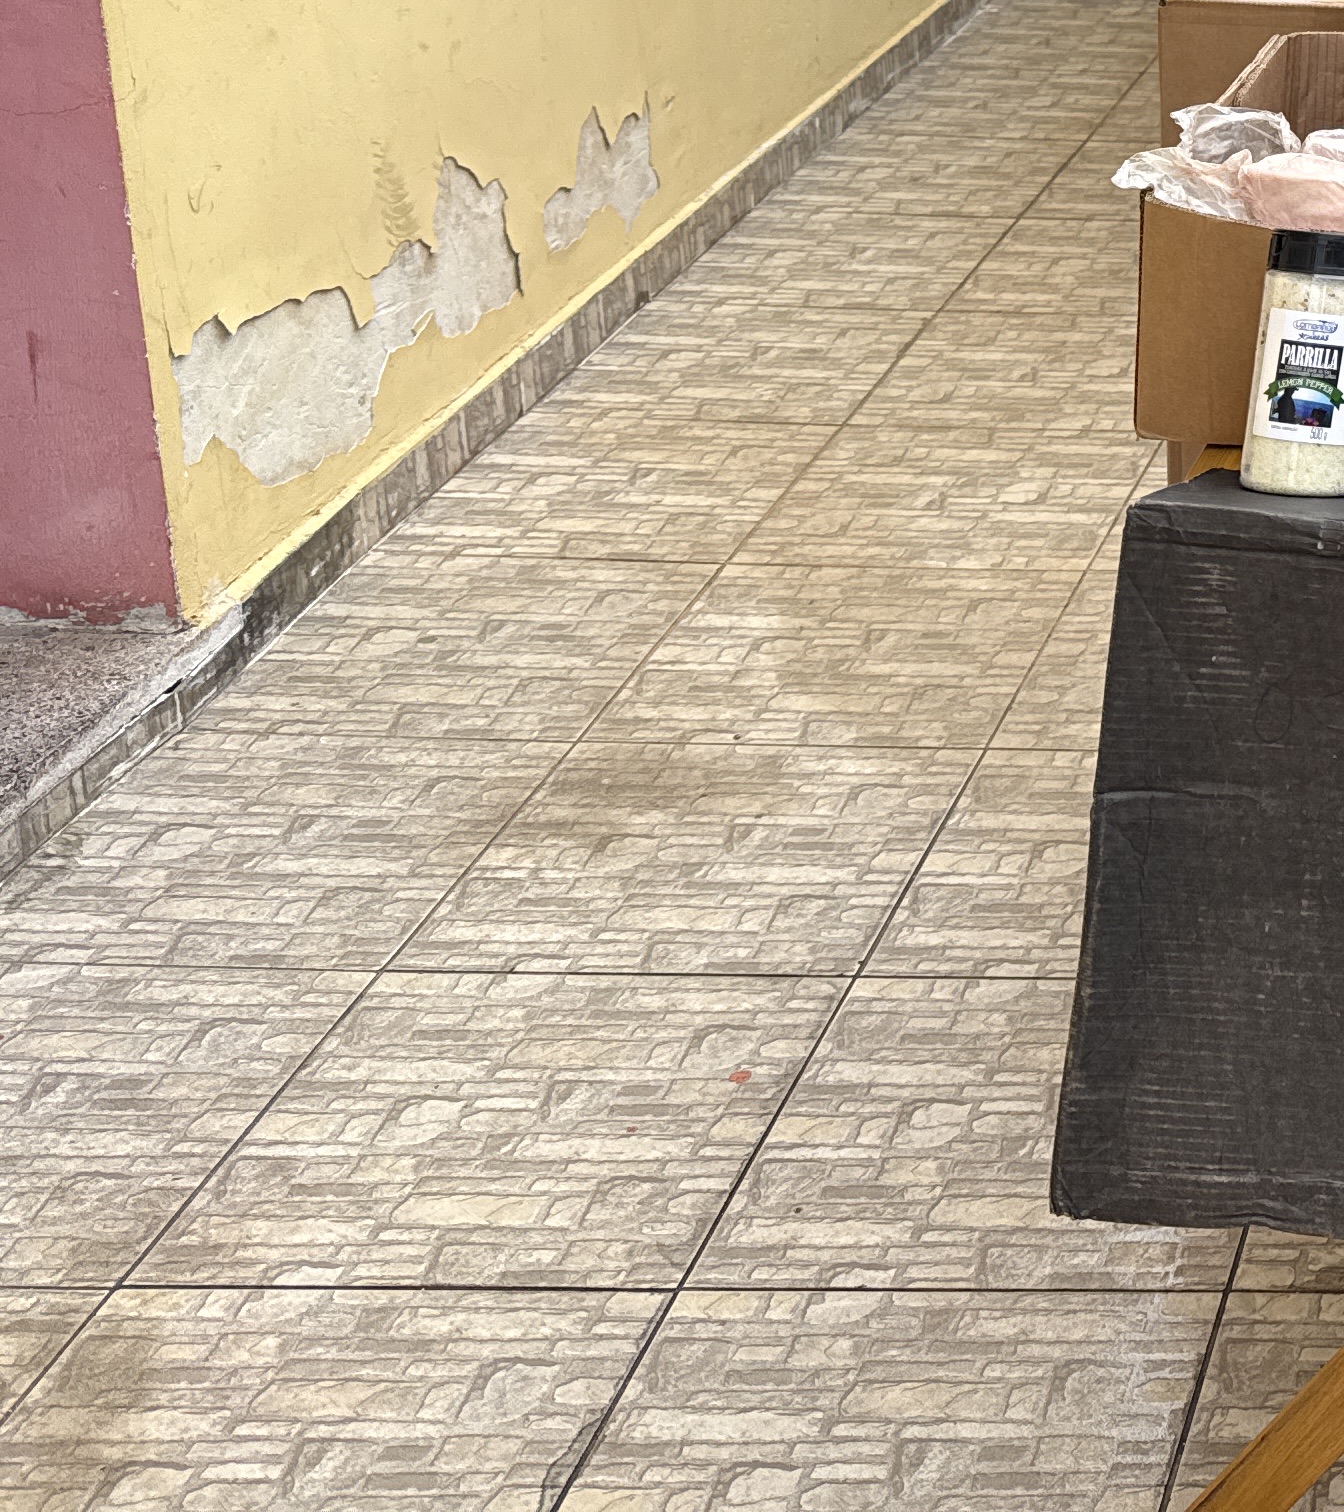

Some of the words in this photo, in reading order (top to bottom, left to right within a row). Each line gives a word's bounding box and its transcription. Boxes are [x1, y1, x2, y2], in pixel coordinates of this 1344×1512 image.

[1281, 343, 1339, 370] PARRILLA
[1278, 377, 1303, 389] LEMON
[1306, 379, 1334, 394] PEPPER
